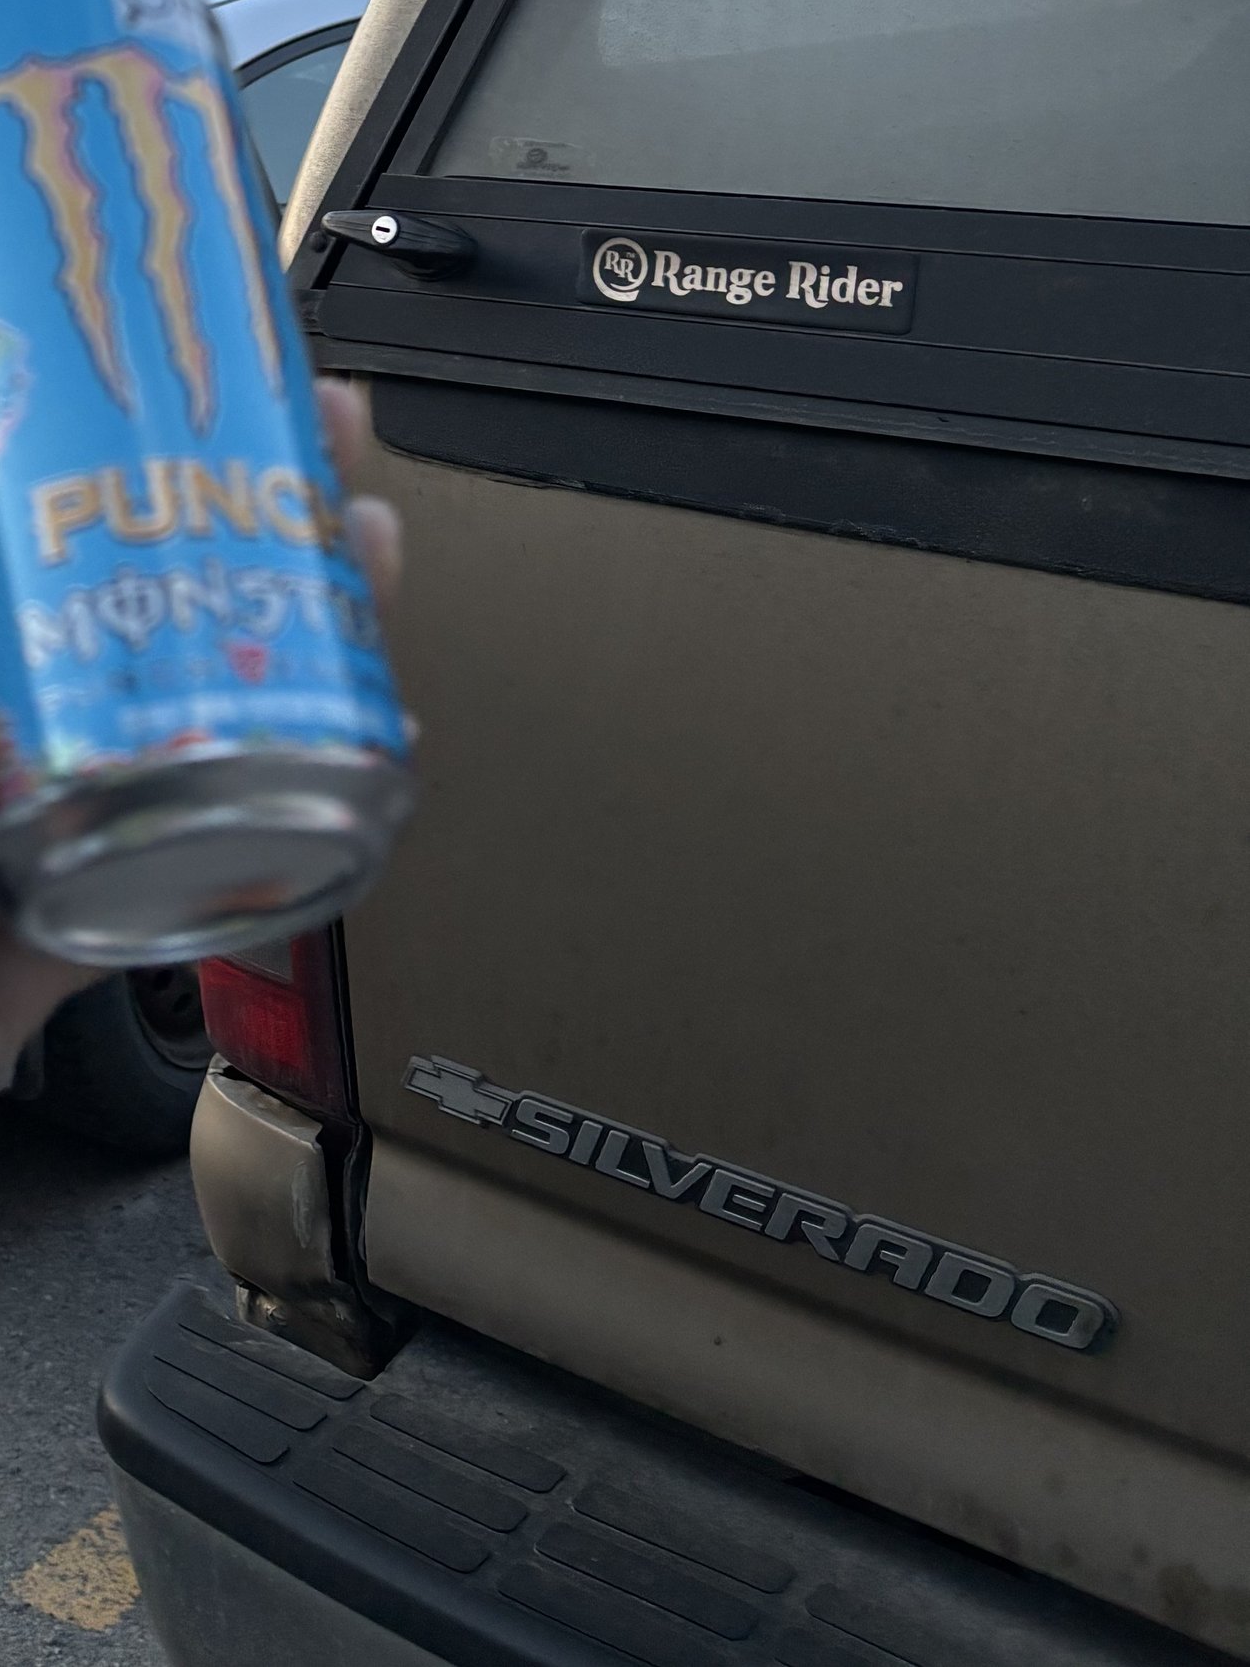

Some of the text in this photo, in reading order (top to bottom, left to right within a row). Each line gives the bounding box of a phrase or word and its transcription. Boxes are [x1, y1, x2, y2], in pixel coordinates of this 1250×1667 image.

[651, 249, 776, 306] Range
[786, 260, 904, 309] Rider
[511, 1092, 1115, 1351] SILVERADO
